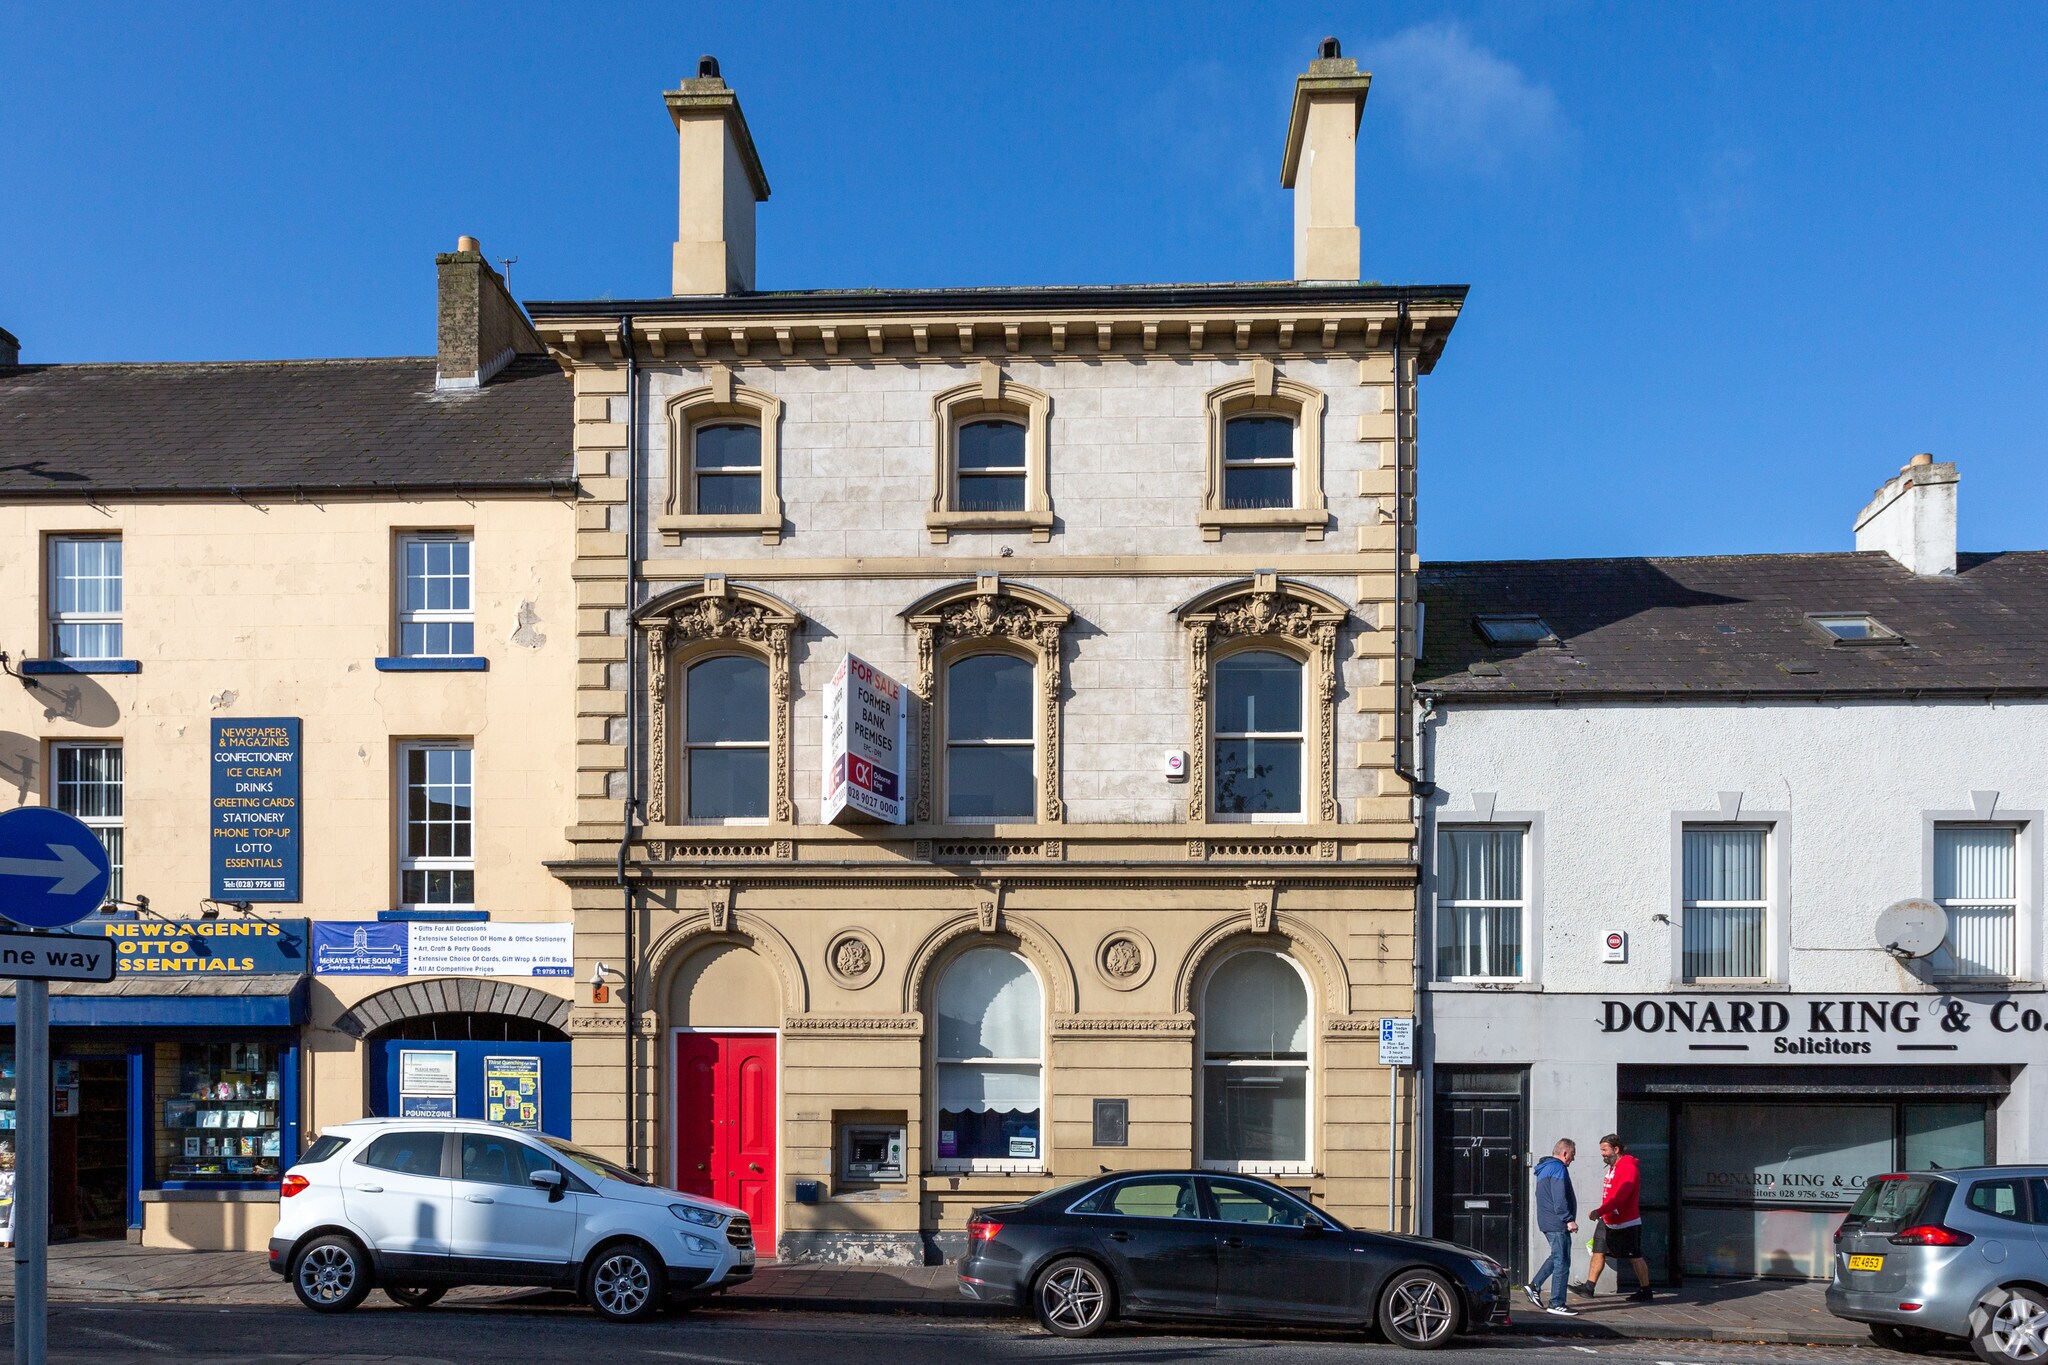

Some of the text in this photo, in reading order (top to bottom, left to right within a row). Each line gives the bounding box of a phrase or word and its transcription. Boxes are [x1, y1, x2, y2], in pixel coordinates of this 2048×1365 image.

[851, 659, 872, 685] FOR
[874, 674, 899, 700] SALE
[858, 687, 891, 716] FORMER
[862, 708, 885, 731] BANK
[221, 727, 287, 738] NEWSPAPERS
[855, 722, 892, 751] PREMISES
[218, 737, 290, 747] & MAGAZINES
[214, 752, 294, 762] CONFECTIONERY
[226, 767, 282, 777] ICE CREAM
[873, 771, 891, 786] Osborne
[235, 782, 273, 793] DRINKS
[213, 797, 295, 808] GREETING CARDS
[848, 786, 860, 800] 028
[861, 793, 878, 808] 9027
[880, 800, 898, 816] 0000
[223, 812, 285, 823] STATIONERY
[213, 828, 291, 838] PHONE TOP-UP
[235, 843, 272, 853] LOTTO
[225, 858, 283, 868] ESSENTIALS
[105, 923, 280, 937] NEWSAGENTS
[116, 941, 189, 954] OTTO
[3, 949, 100, 971] ne way
[116, 957, 255, 971] SSENTIALS
[319, 957, 402, 965] McKAYS @ THE SQUARE
[1602, 1000, 2048, 1034] DONARD KING & Co.
[1774, 1037, 1871, 1055] Solicitors
[405, 1110, 452, 1118] POUNDZONE
[1470, 1136, 1483, 1147] 27
[1463, 1149, 1490, 1157] A B
[1706, 1172, 1775, 1186] DONARD
[1783, 1173, 1825, 1187] KING
[1832, 1175, 1844, 1187] &
[1735, 1187, 1840, 1199] Solicitors 028 9756 5625
[1861, 1257, 1879, 1268] 4853
